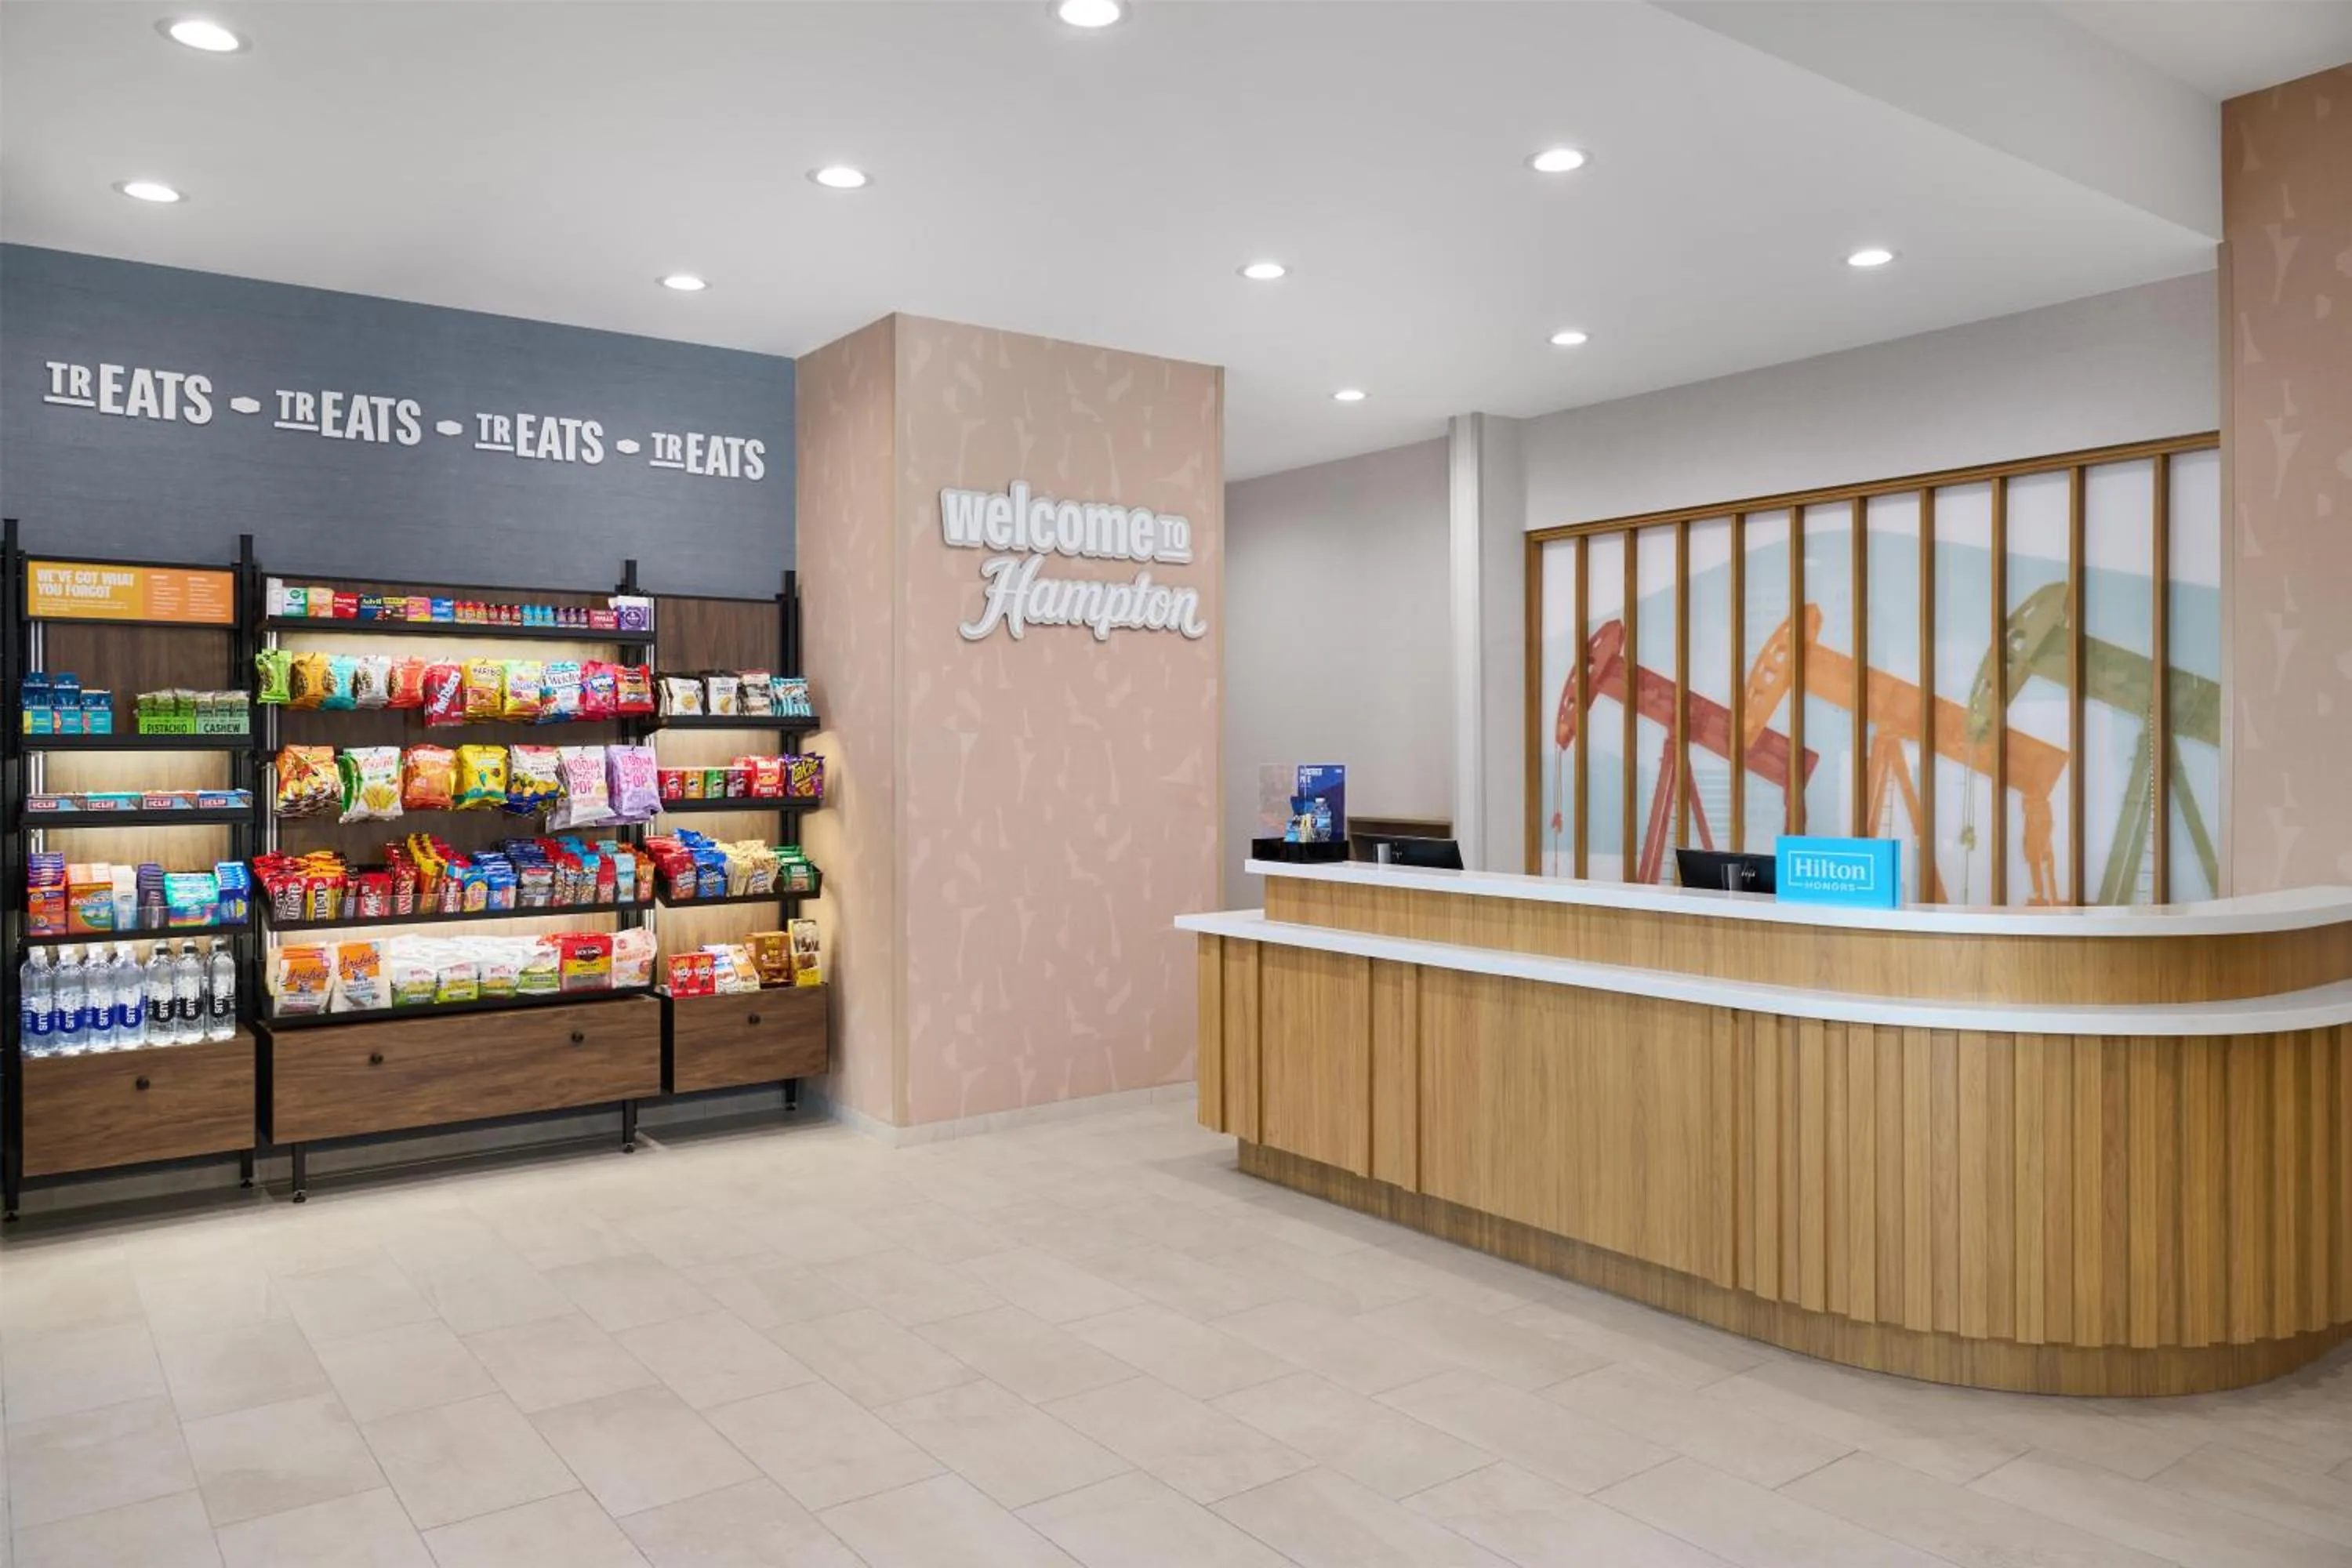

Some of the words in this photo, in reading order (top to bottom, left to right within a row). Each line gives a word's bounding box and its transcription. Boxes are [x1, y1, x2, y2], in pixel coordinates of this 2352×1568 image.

[44, 361, 213, 424] TREATS
[274, 390, 422, 446] TREATS
[475, 412, 604, 464] TREATS
[650, 432, 765, 481] TREATS
[944, 481, 1155, 557] welcome
[1160, 519, 1191, 558] TO
[75, 572, 99, 584] GOT
[38, 583, 63, 596] YOU
[960, 555, 1206, 640] Hampton
[147, 724, 187, 732] PISTACHIO
[204, 724, 241, 732] CASHEW
[1795, 858, 1866, 880] Hilton
[1804, 880, 1857, 891] HONORS
